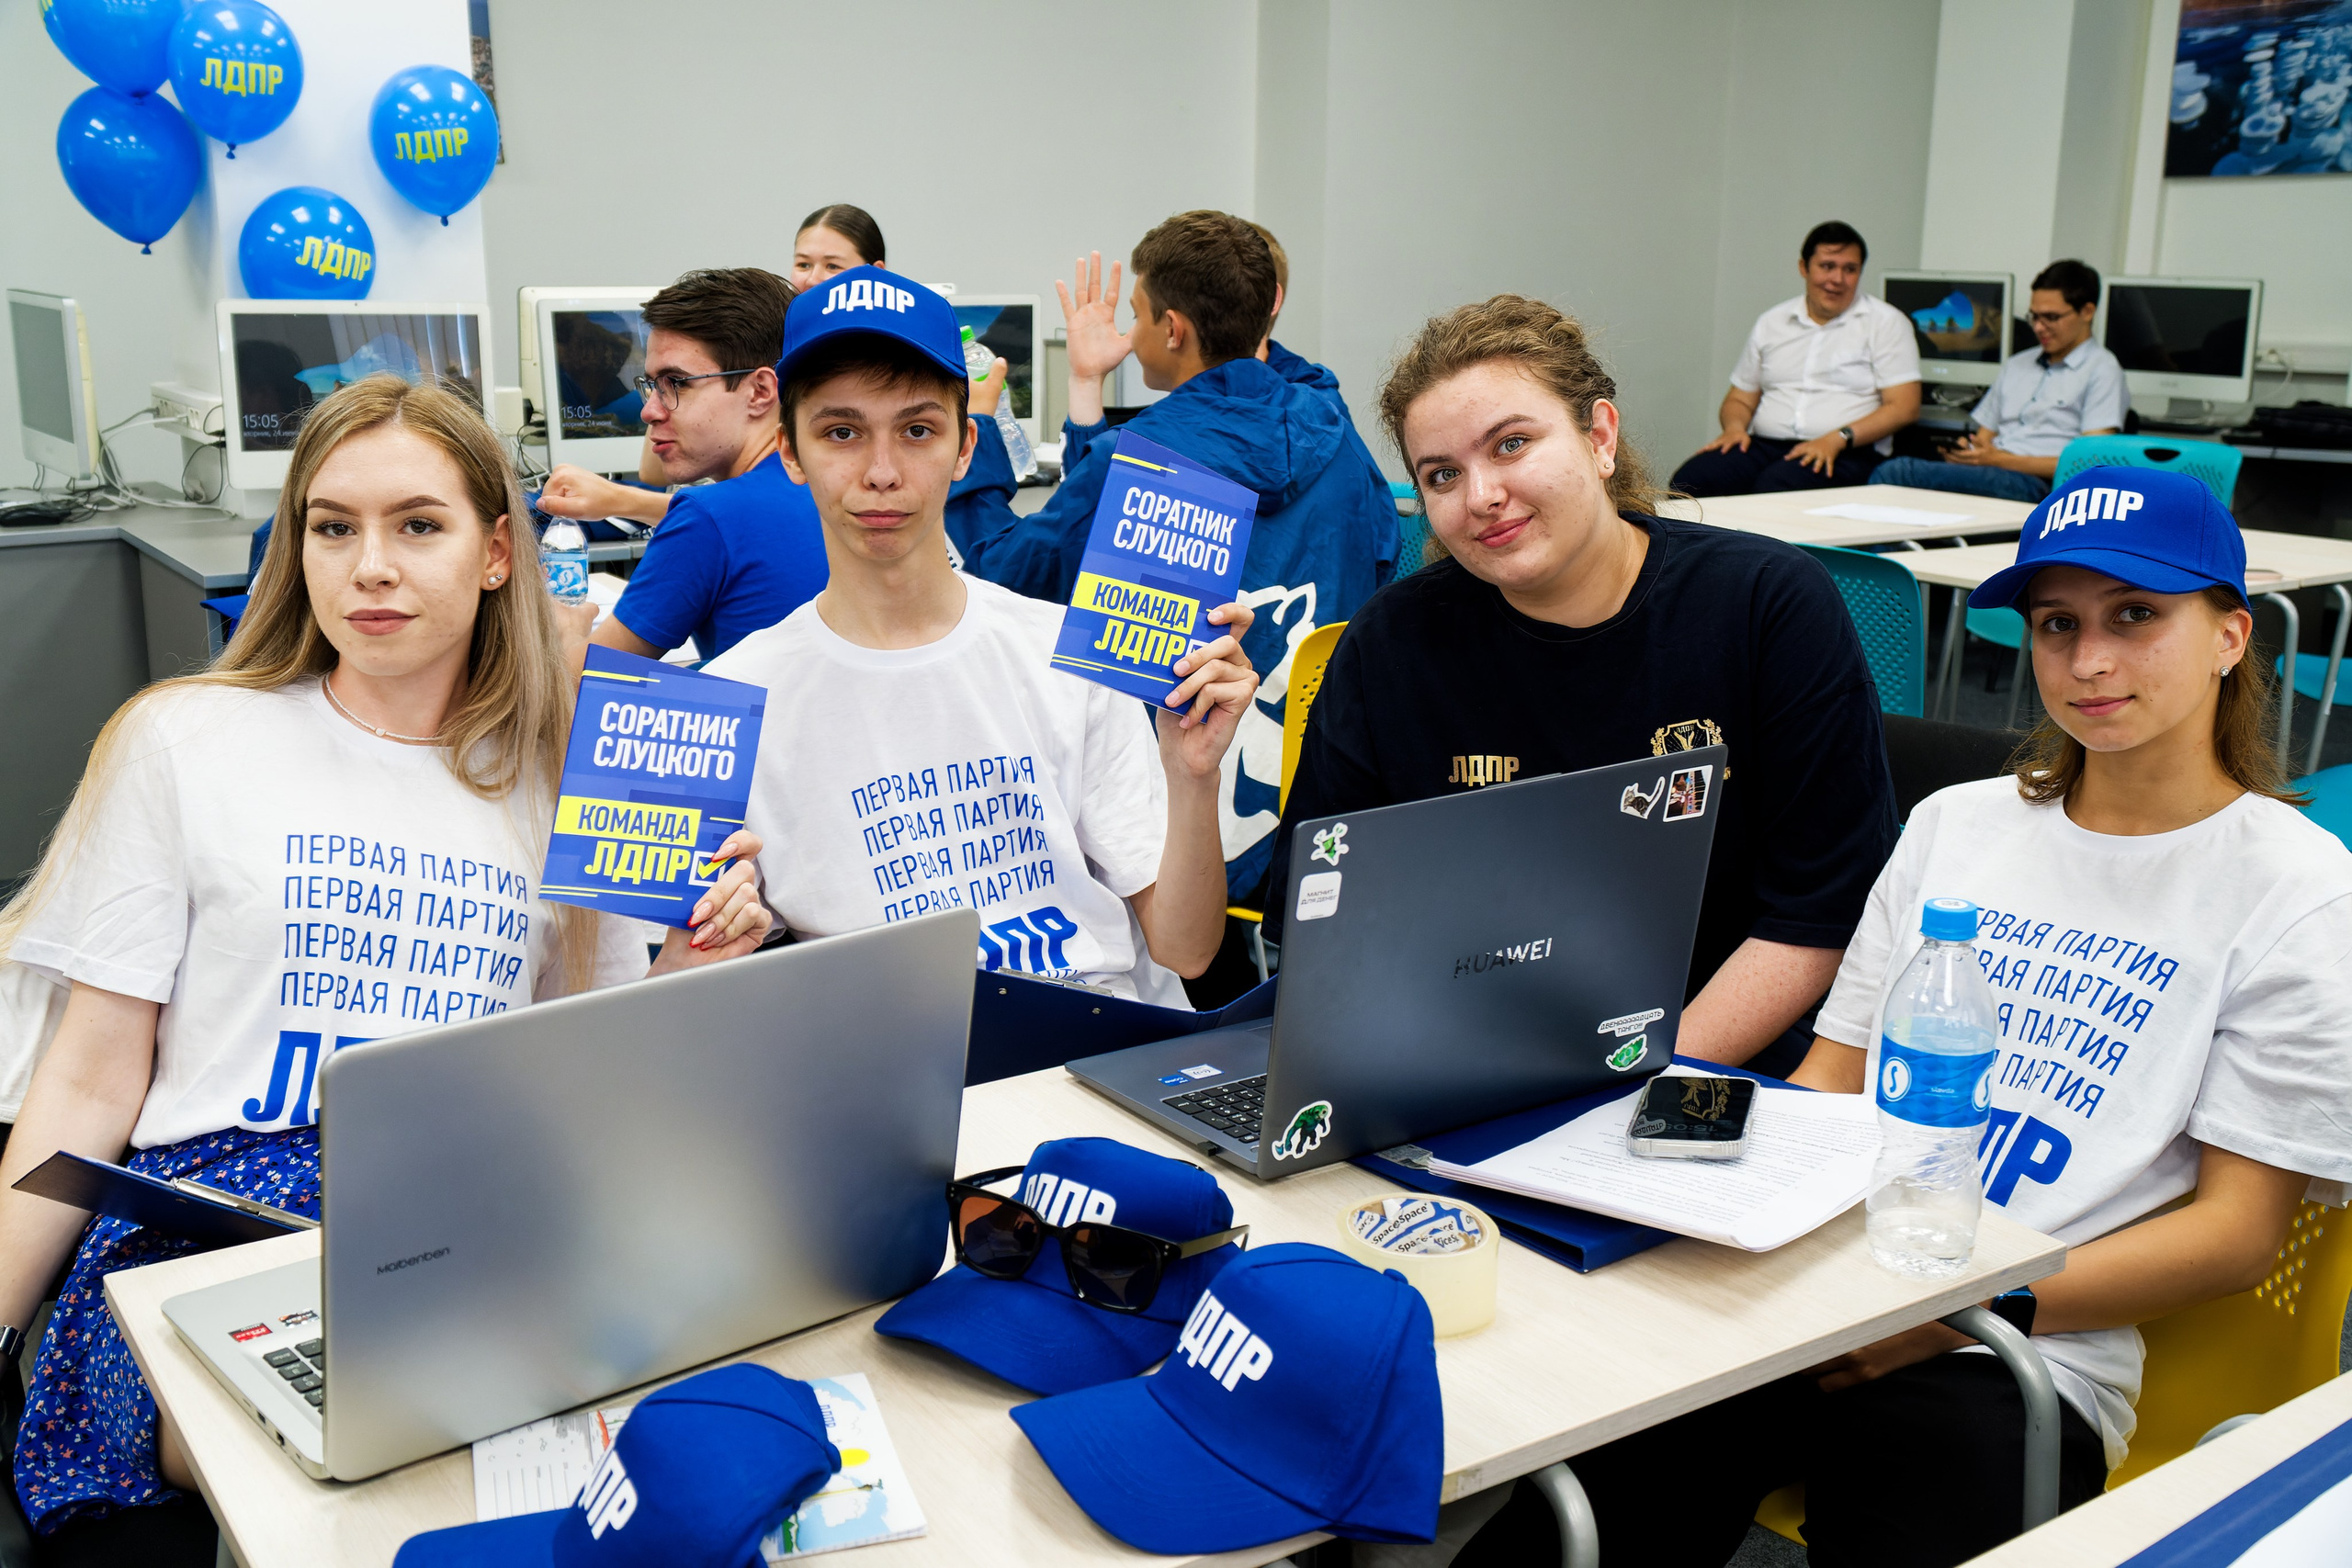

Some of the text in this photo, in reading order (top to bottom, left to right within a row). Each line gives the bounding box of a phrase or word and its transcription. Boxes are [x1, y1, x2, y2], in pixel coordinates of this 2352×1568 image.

[199, 58, 283, 97] ЛДПР
[395, 127, 469, 164] ЛДПР
[295, 236, 371, 281] ЛДПР
[821, 279, 915, 315] ЛДПР
[243, 414, 279, 428] 15:05
[561, 406, 592, 419] 15:05
[1122, 487, 1237, 546] СОРАТНИК
[2039, 487, 2143, 539] ЛДПР
[1113, 519, 1230, 576] СЛУЦКОГО
[1092, 581, 1190, 628] КОМАНДА
[1094, 618, 1186, 667] ЛДПР
[600, 702, 741, 747] СОРАТНИК
[593, 736, 736, 781] СЛУЦКОГО
[1448, 755, 1520, 786] ЛДПР
[851, 756, 1035, 818] ПЕРВАЯ ПАРТИЯ
[578, 805, 690, 842] КОМАНДА
[863, 793, 1045, 857] ПЕРВАЯ ПАРТИЯ
[286, 834, 527, 904] ПЕРВАЯ ПАРТИЯ
[584, 840, 691, 885] ЛДПР
[873, 826, 1049, 896] ПЕРВАЯ ПАРТИЯ
[968, 860, 1055, 910] ПАРТИЯ
[284, 875, 529, 946] ПЕРВАЯ ПАРТИЯ
[284, 922, 523, 990] ПЕРВАЯ ПАРТИЯ
[1453, 937, 1553, 978] HUAWEI
[2053, 929, 2180, 992] ПАРТИЯ
[280, 971, 389, 1014] ПЕРВАЯ
[2032, 964, 2154, 1033] ПАРТИЯ
[2018, 1009, 2129, 1076] ПАРТИЯ
[2000, 1053, 2105, 1119] ПАРТИЯ
